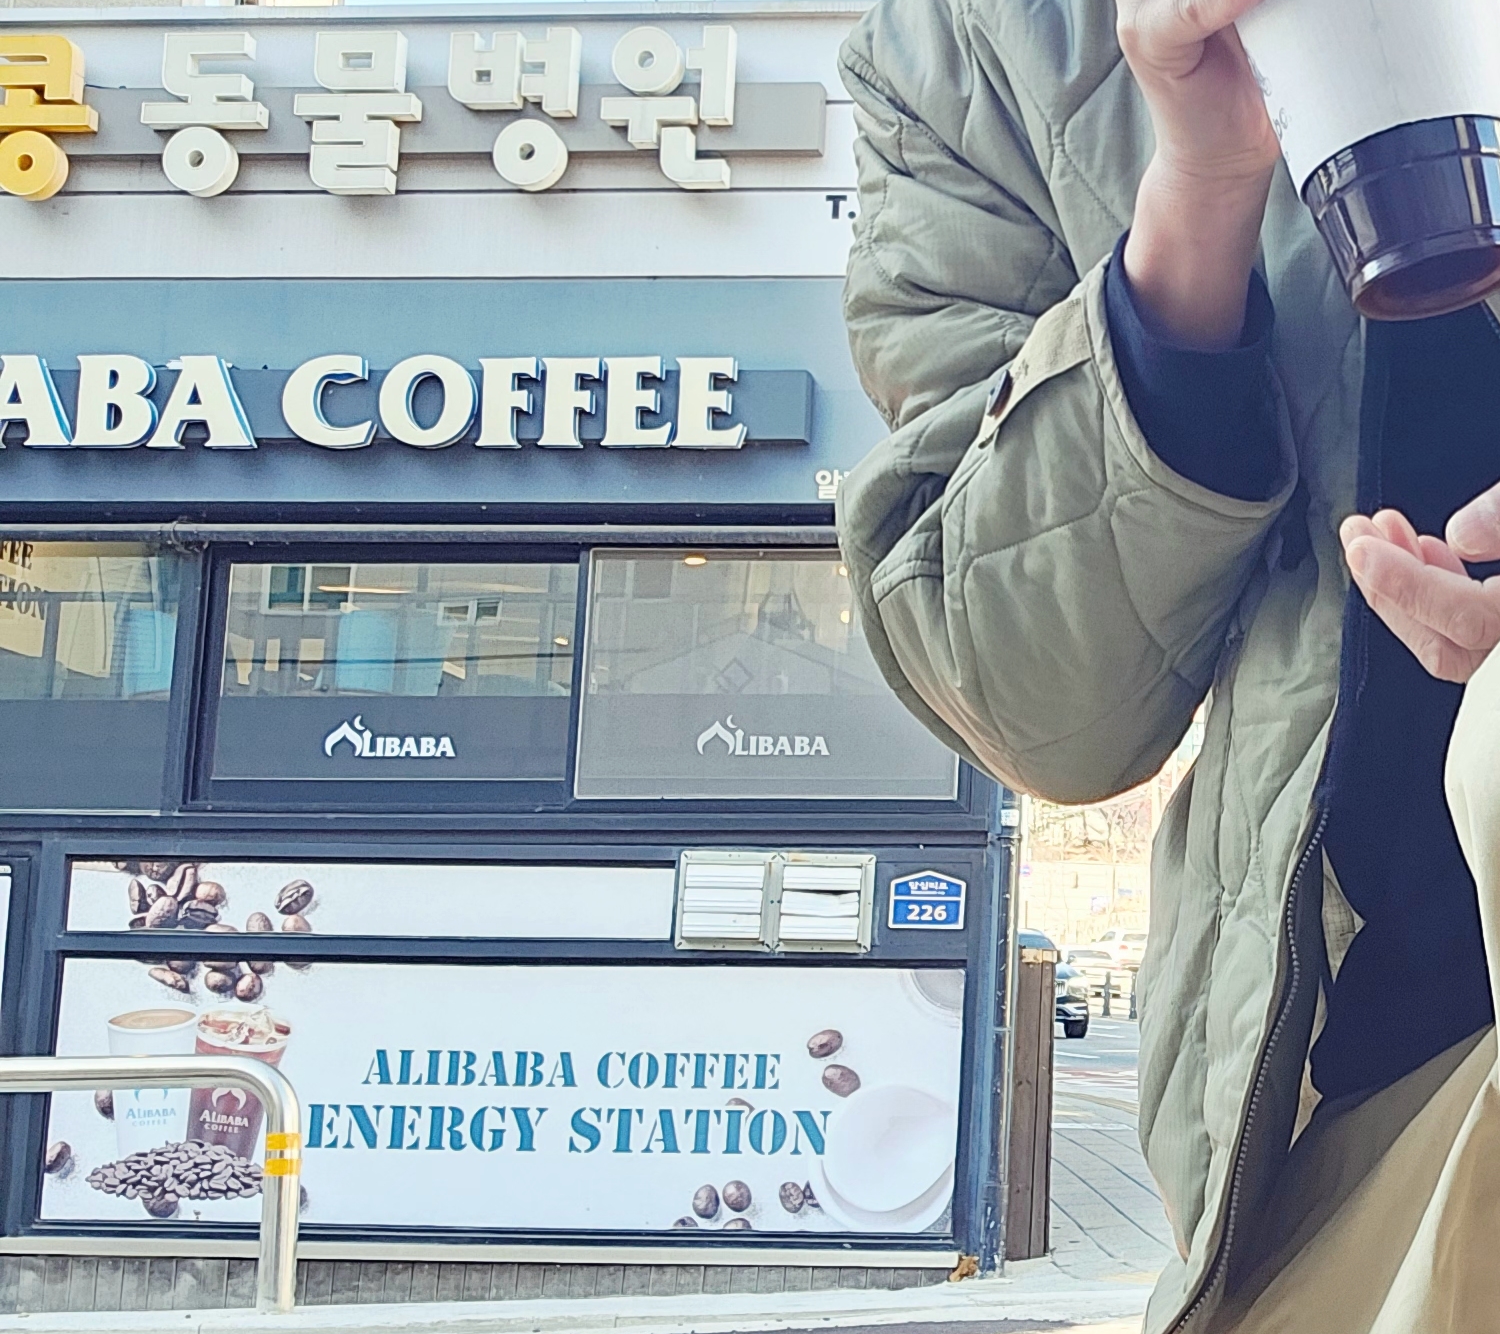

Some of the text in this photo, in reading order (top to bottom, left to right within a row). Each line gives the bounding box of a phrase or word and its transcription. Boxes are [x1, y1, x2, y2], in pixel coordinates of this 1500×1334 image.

[140, 25, 737, 197] 동물병원
[281, 354, 747, 450] COFFEE
[906, 905, 947, 921] 226
[361, 1049, 781, 1090] ALIBABA COFFEE
[199, 1109, 250, 1128] ALIBABA
[203, 1123, 240, 1134] COFFEE
[304, 1104, 833, 1156] ENERGY STATION
